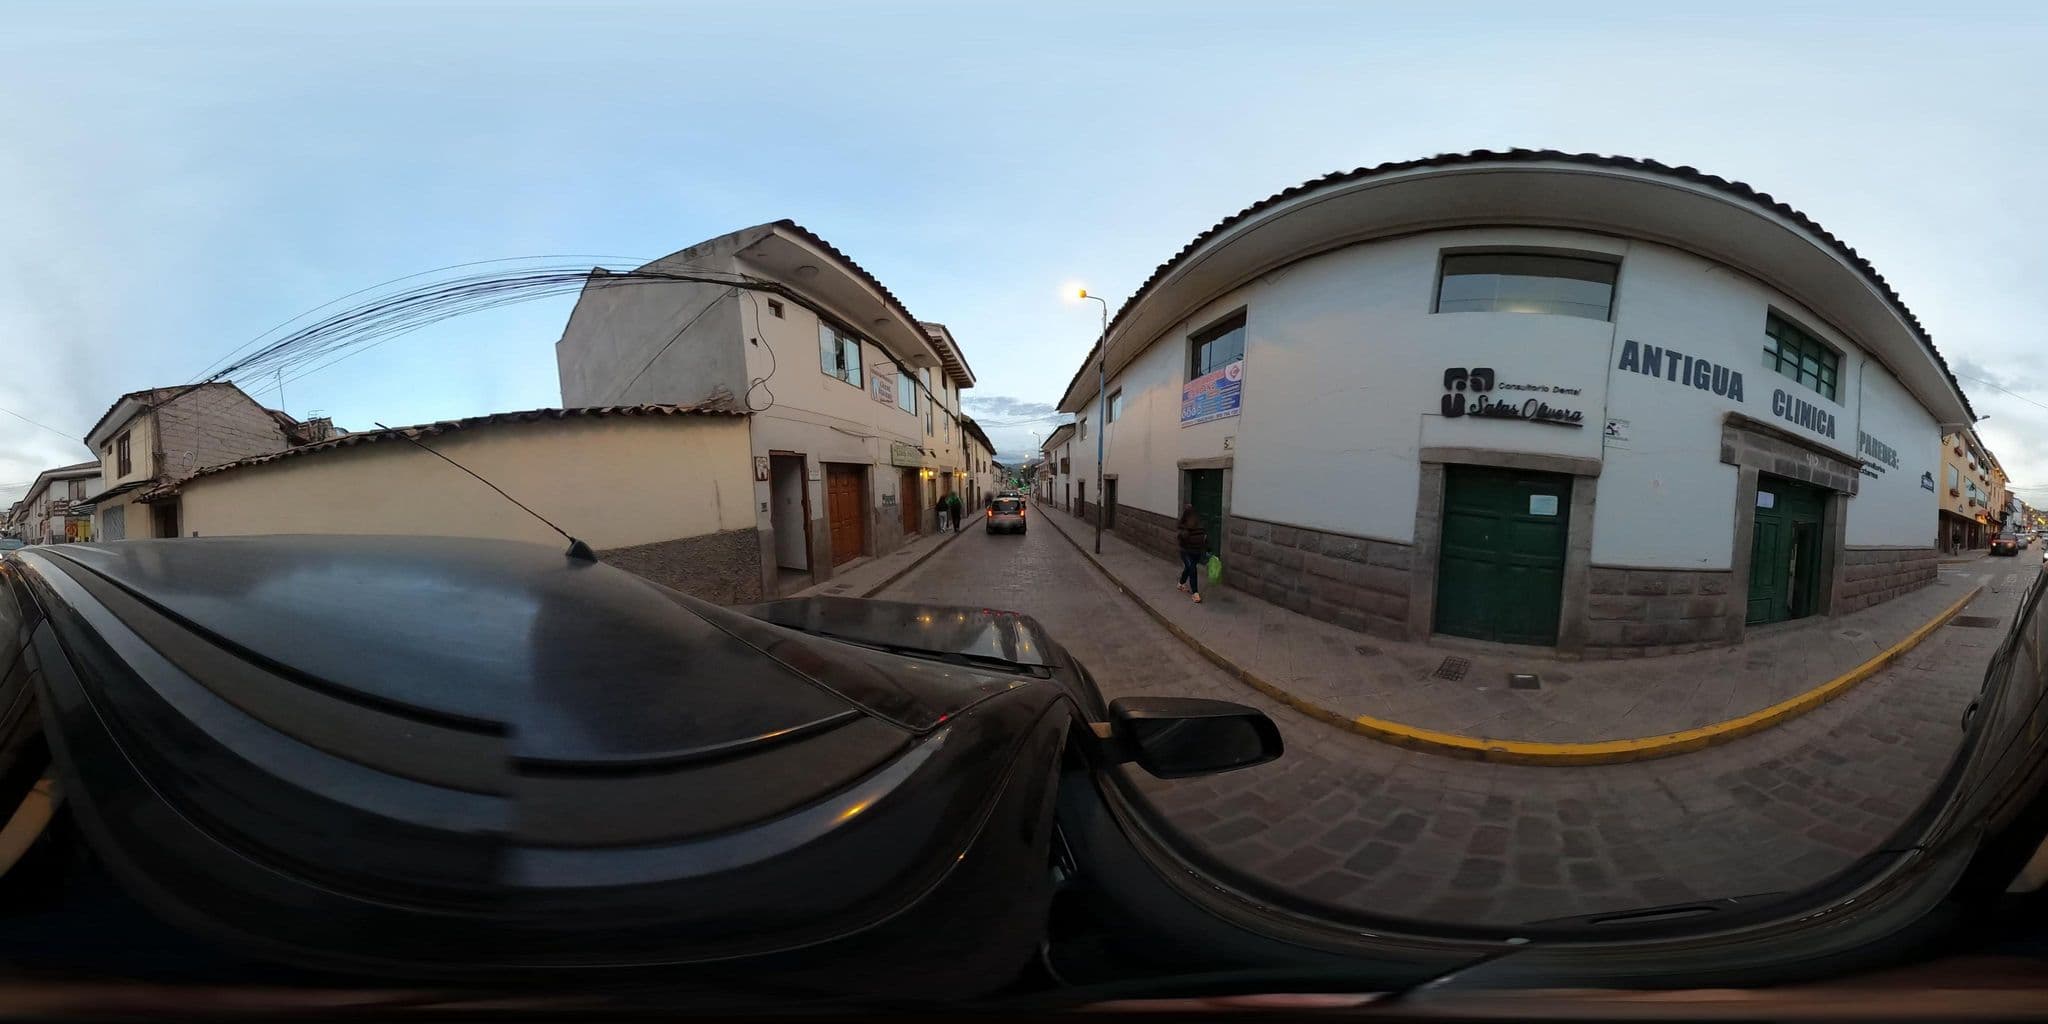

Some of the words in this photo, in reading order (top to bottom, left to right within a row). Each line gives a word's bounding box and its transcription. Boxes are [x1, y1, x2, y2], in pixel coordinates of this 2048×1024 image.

[1498, 382, 1549, 393] Consultorio
[1552, 386, 1582, 396] Dental
[1469, 394, 1520, 416] Salas
[1522, 398, 1584, 422] Olivera
[1618, 339, 1744, 403] ANTIGUA
[1771, 388, 1835, 439] CLINICA
[1859, 430, 1899, 470] PAREDES:
